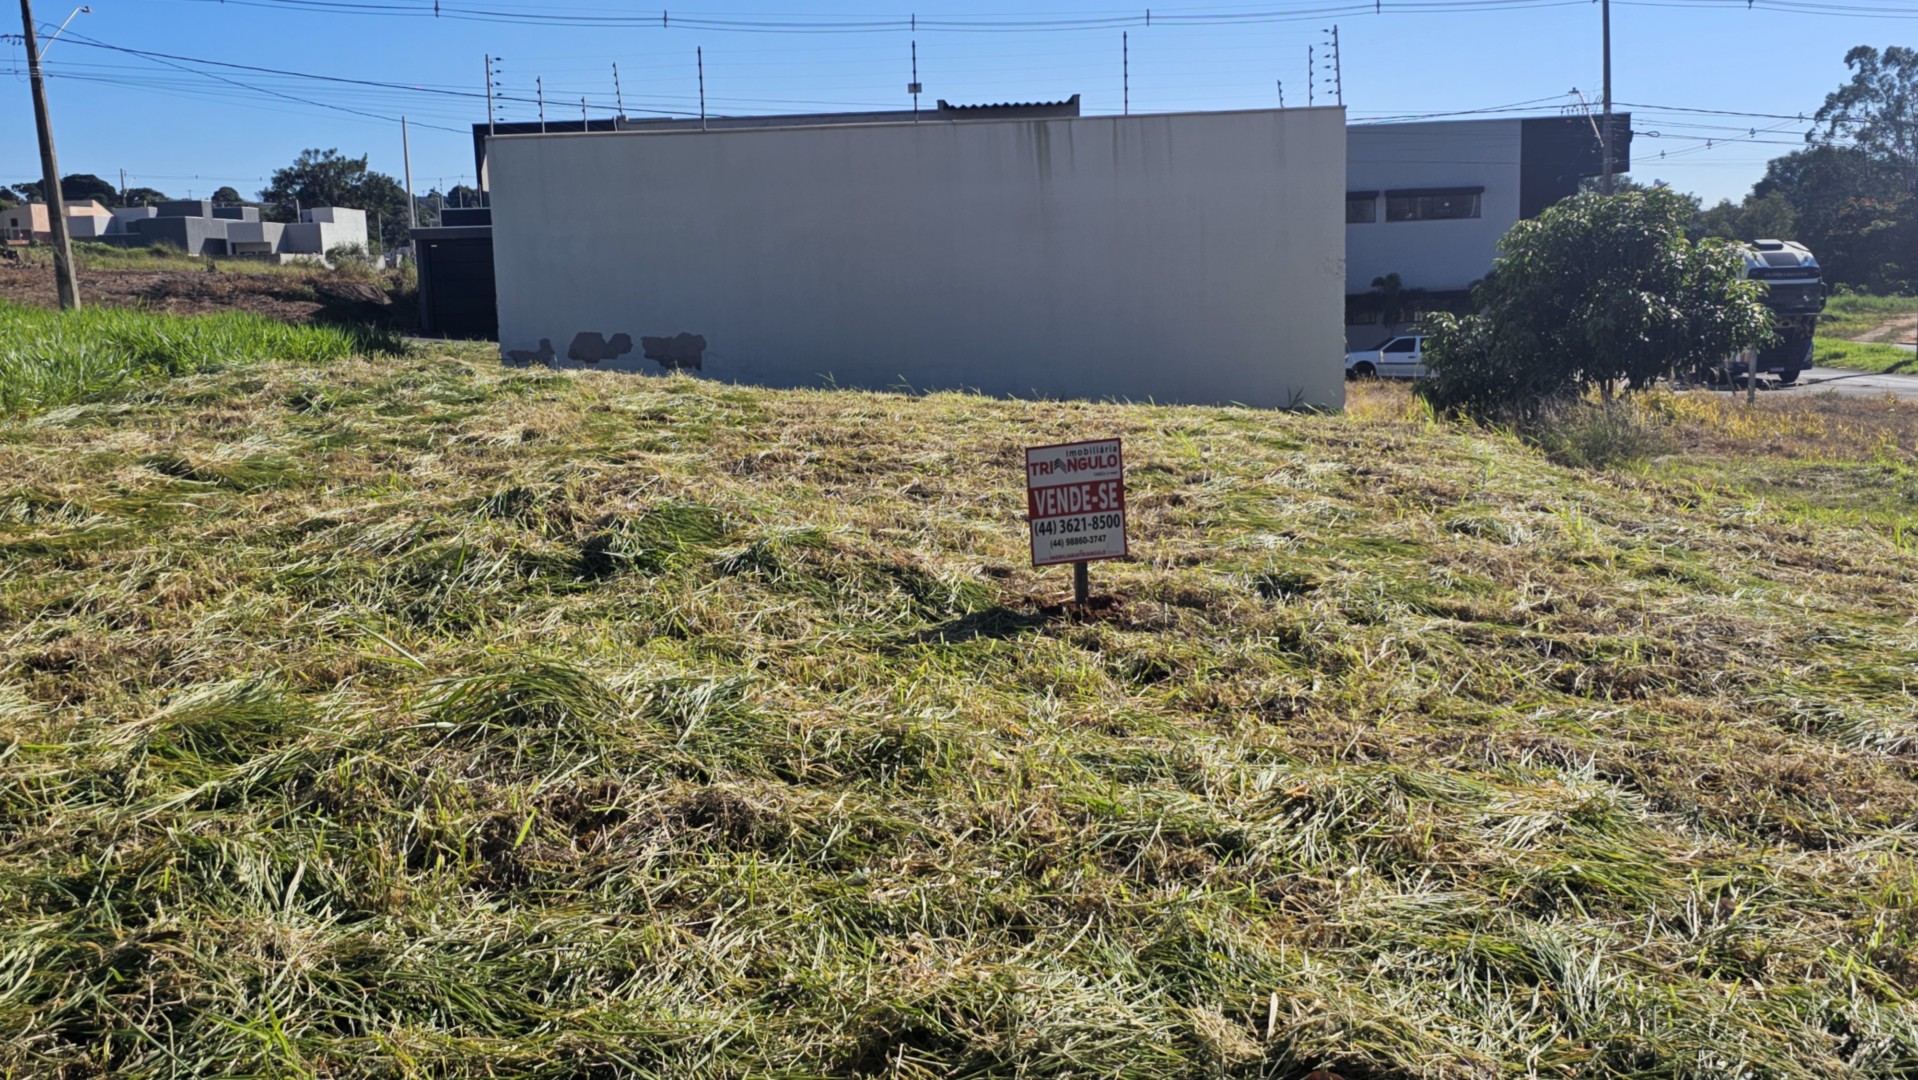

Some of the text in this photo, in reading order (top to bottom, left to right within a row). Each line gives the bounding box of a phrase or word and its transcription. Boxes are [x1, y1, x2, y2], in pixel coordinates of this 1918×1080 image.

[1034, 482, 1118, 516] VENDE-SE
[1034, 514, 1120, 537] (44) 3621-8500
[1050, 539, 1064, 549] (44)
